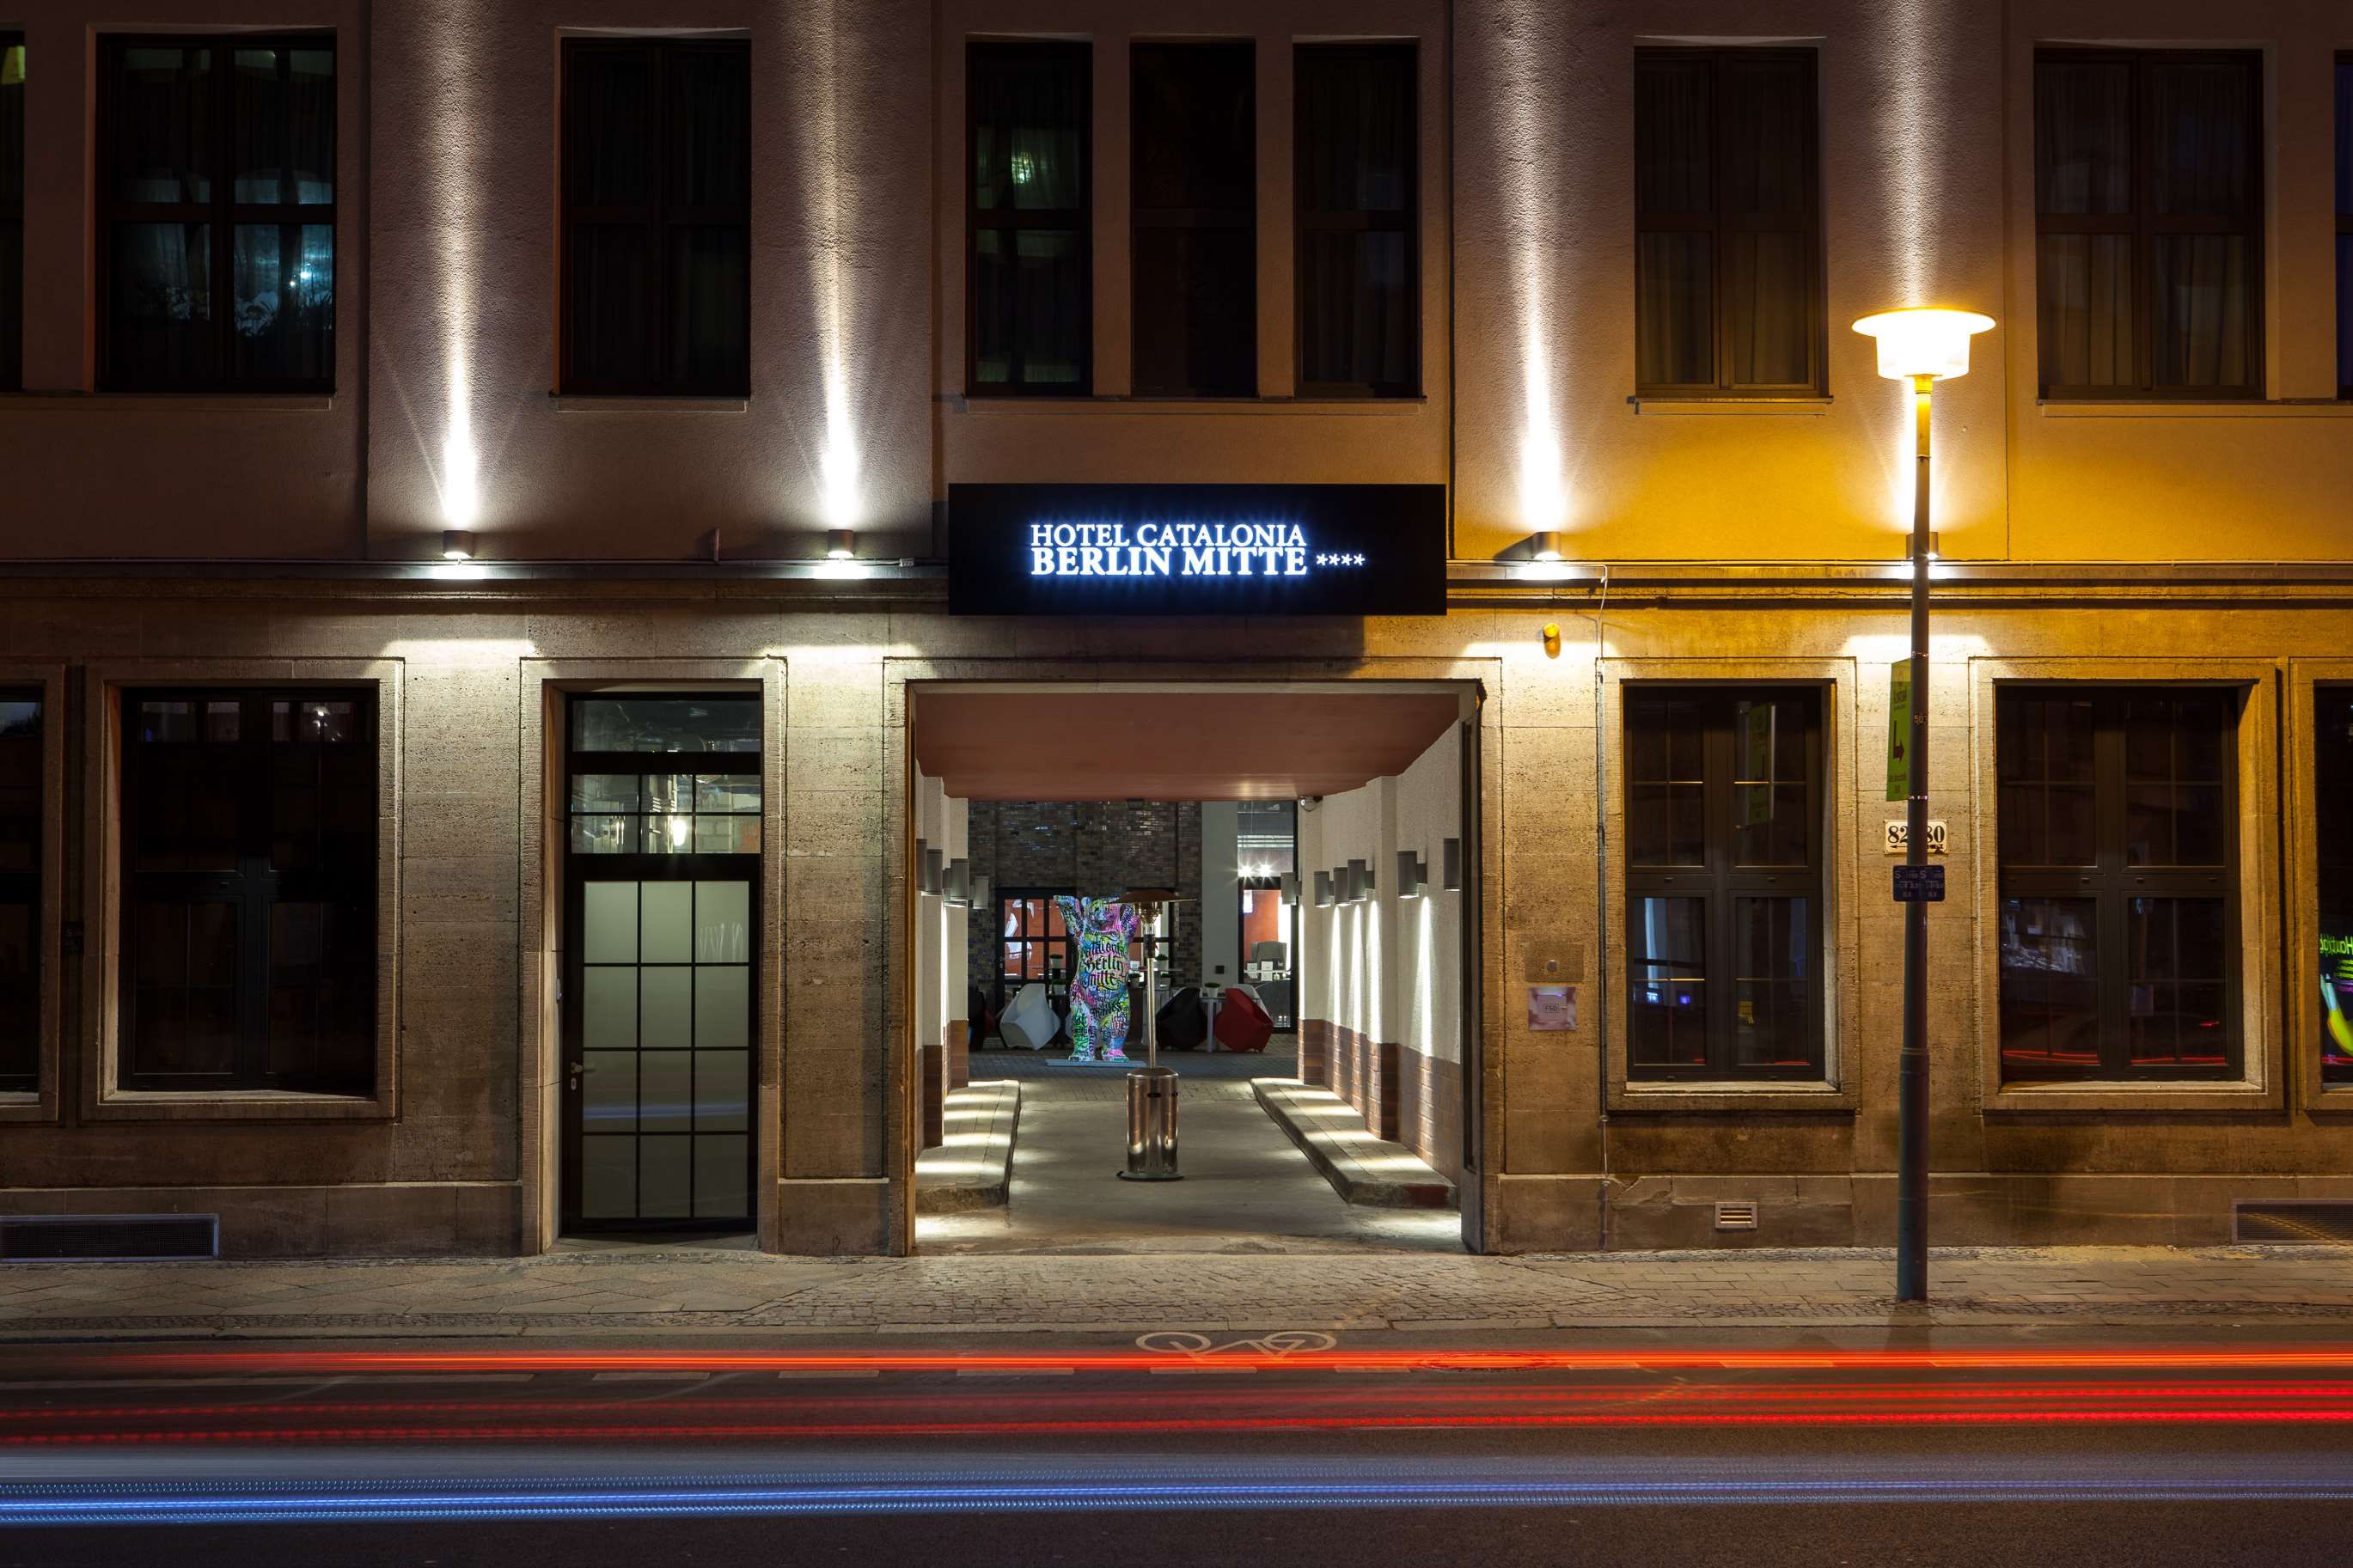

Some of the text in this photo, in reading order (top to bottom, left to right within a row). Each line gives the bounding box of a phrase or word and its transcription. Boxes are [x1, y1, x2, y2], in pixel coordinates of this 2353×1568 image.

[1031, 523, 1306, 546] HOTEL CATALONIA
[1031, 546, 1307, 575] BERLIN MITTE
[1888, 826, 1909, 843] 82
